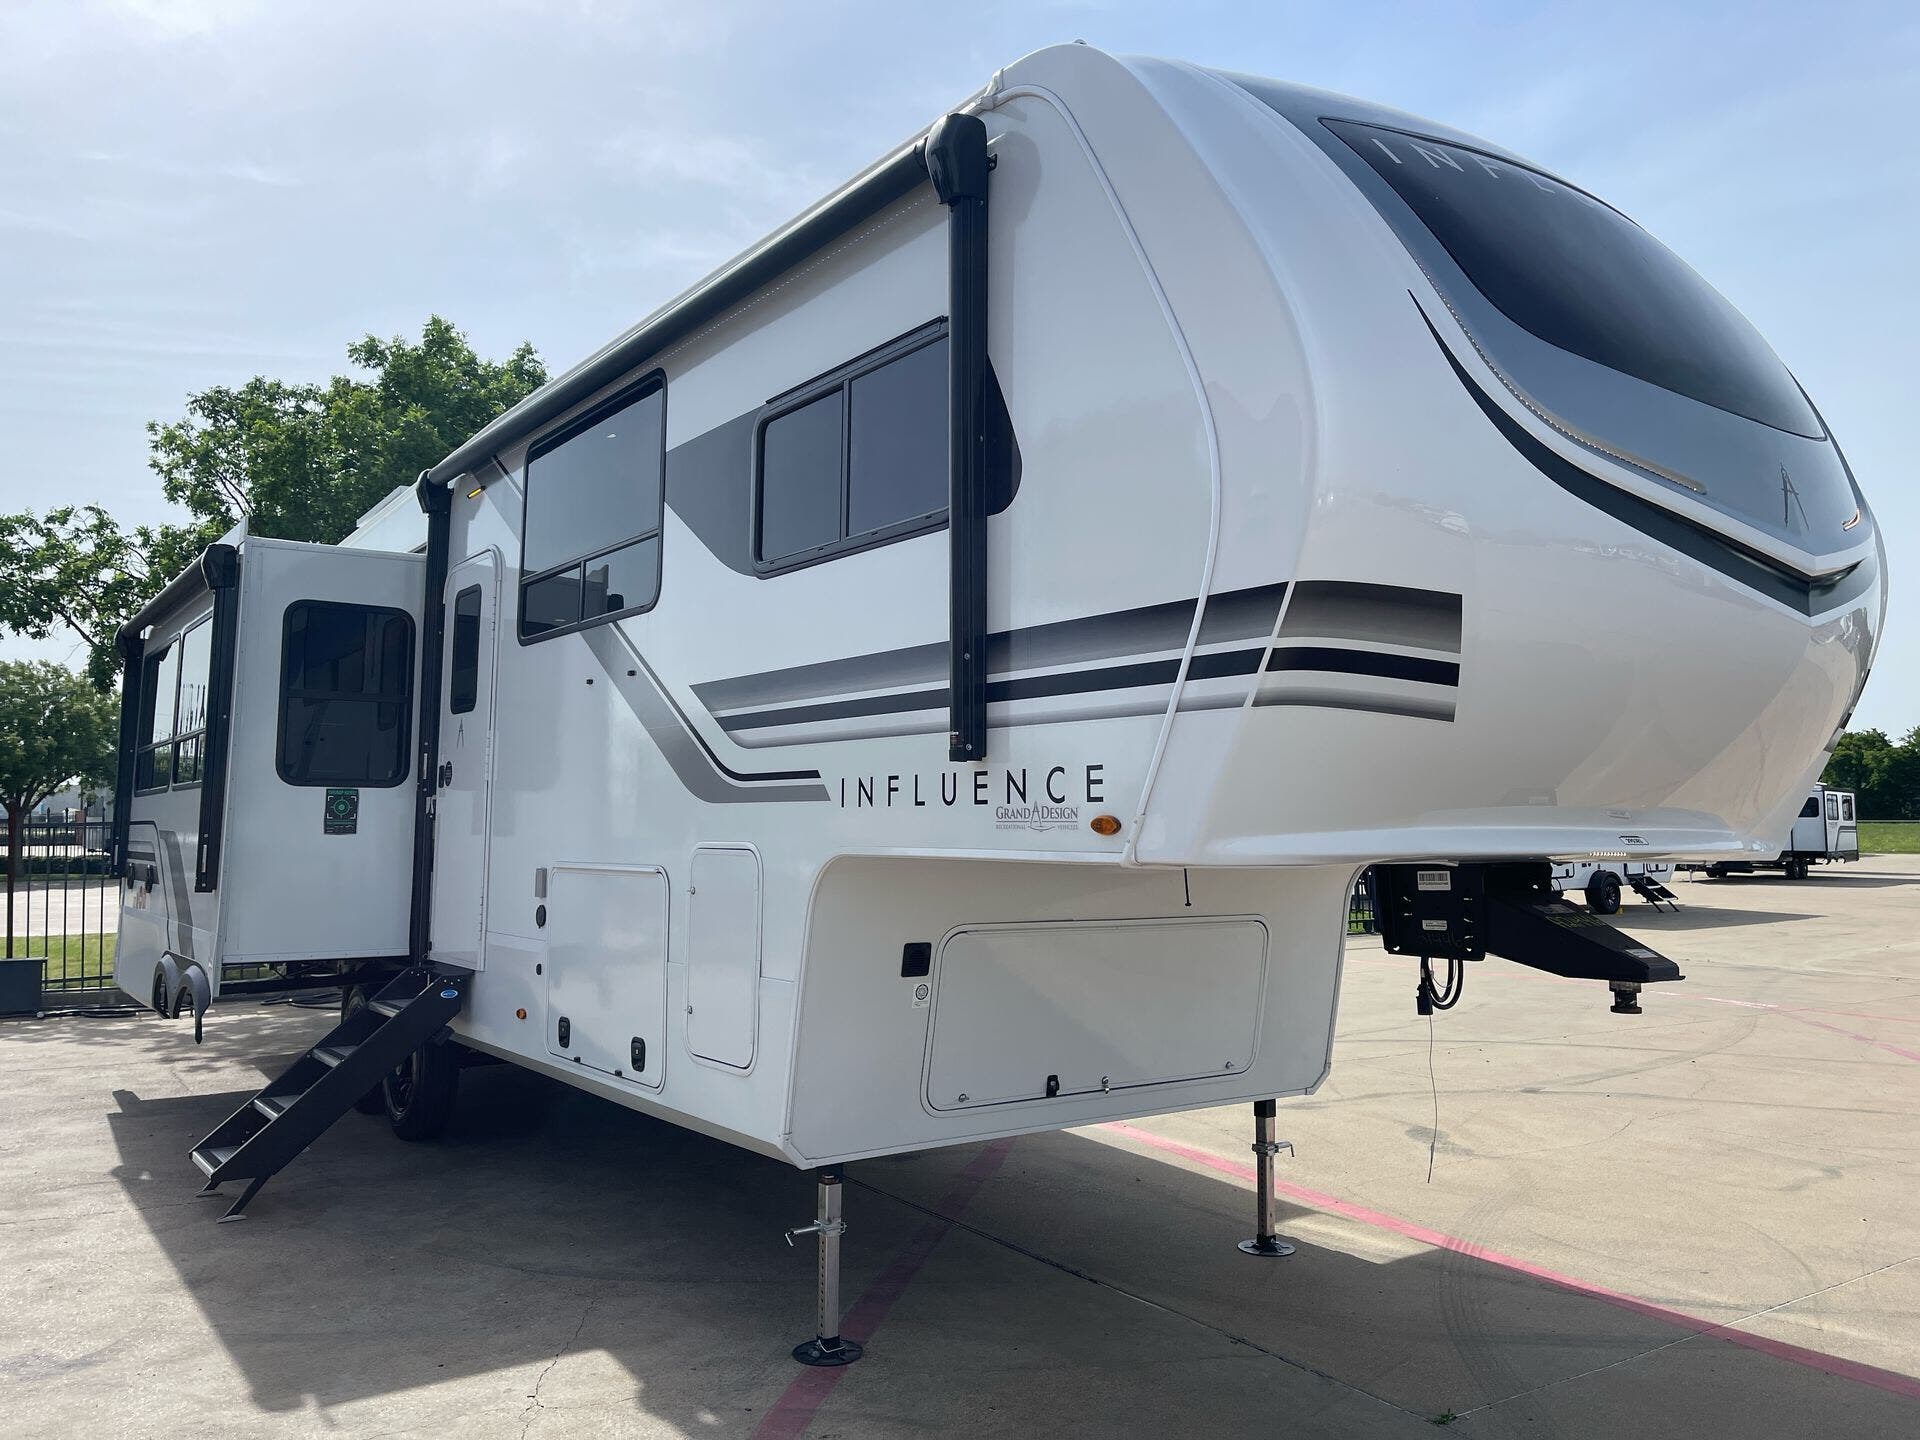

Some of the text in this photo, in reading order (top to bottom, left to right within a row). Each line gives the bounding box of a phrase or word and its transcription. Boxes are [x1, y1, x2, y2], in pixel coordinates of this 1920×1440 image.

[840, 764, 1105, 808] INFLUENCE
[995, 806, 1079, 820] GRAND DESIGN
